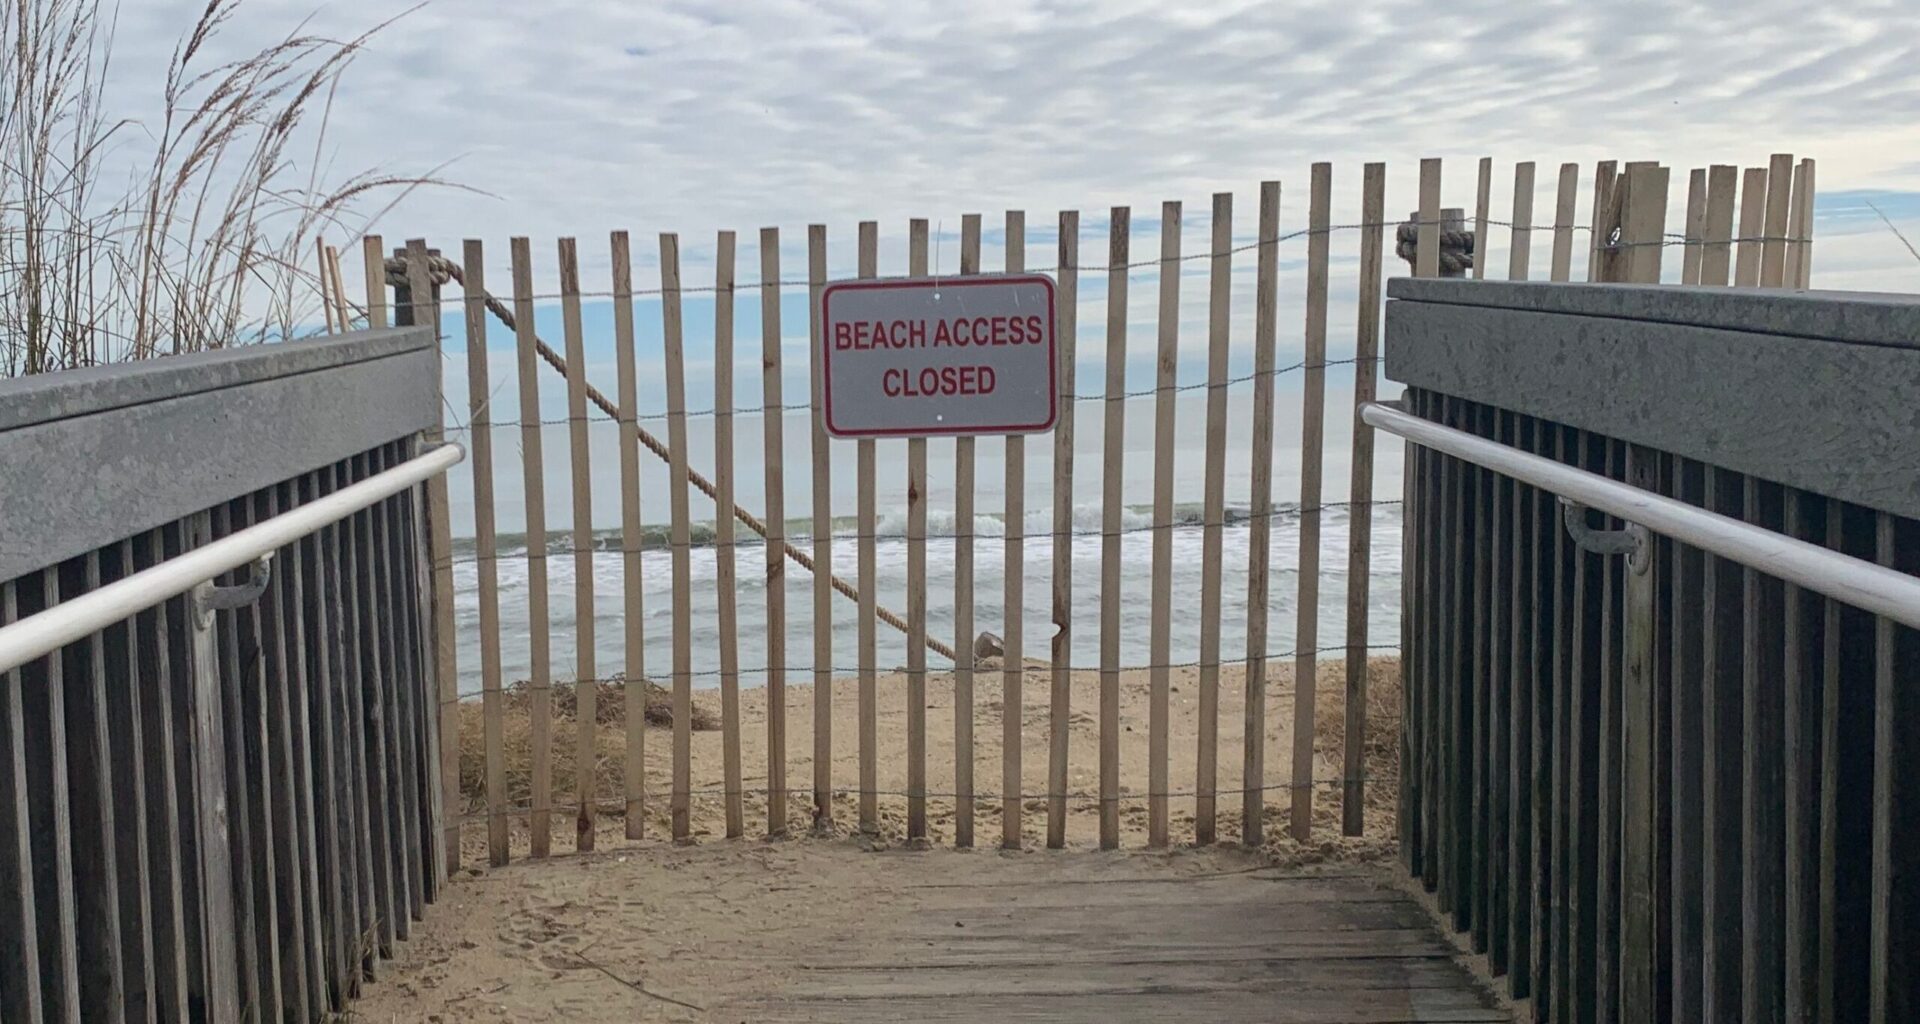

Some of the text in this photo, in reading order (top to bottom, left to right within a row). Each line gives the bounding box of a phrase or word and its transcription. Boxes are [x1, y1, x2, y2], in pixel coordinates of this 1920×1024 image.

[835, 316, 1042, 350] BEACH ACCESS
[883, 366, 995, 397] CLOSED
